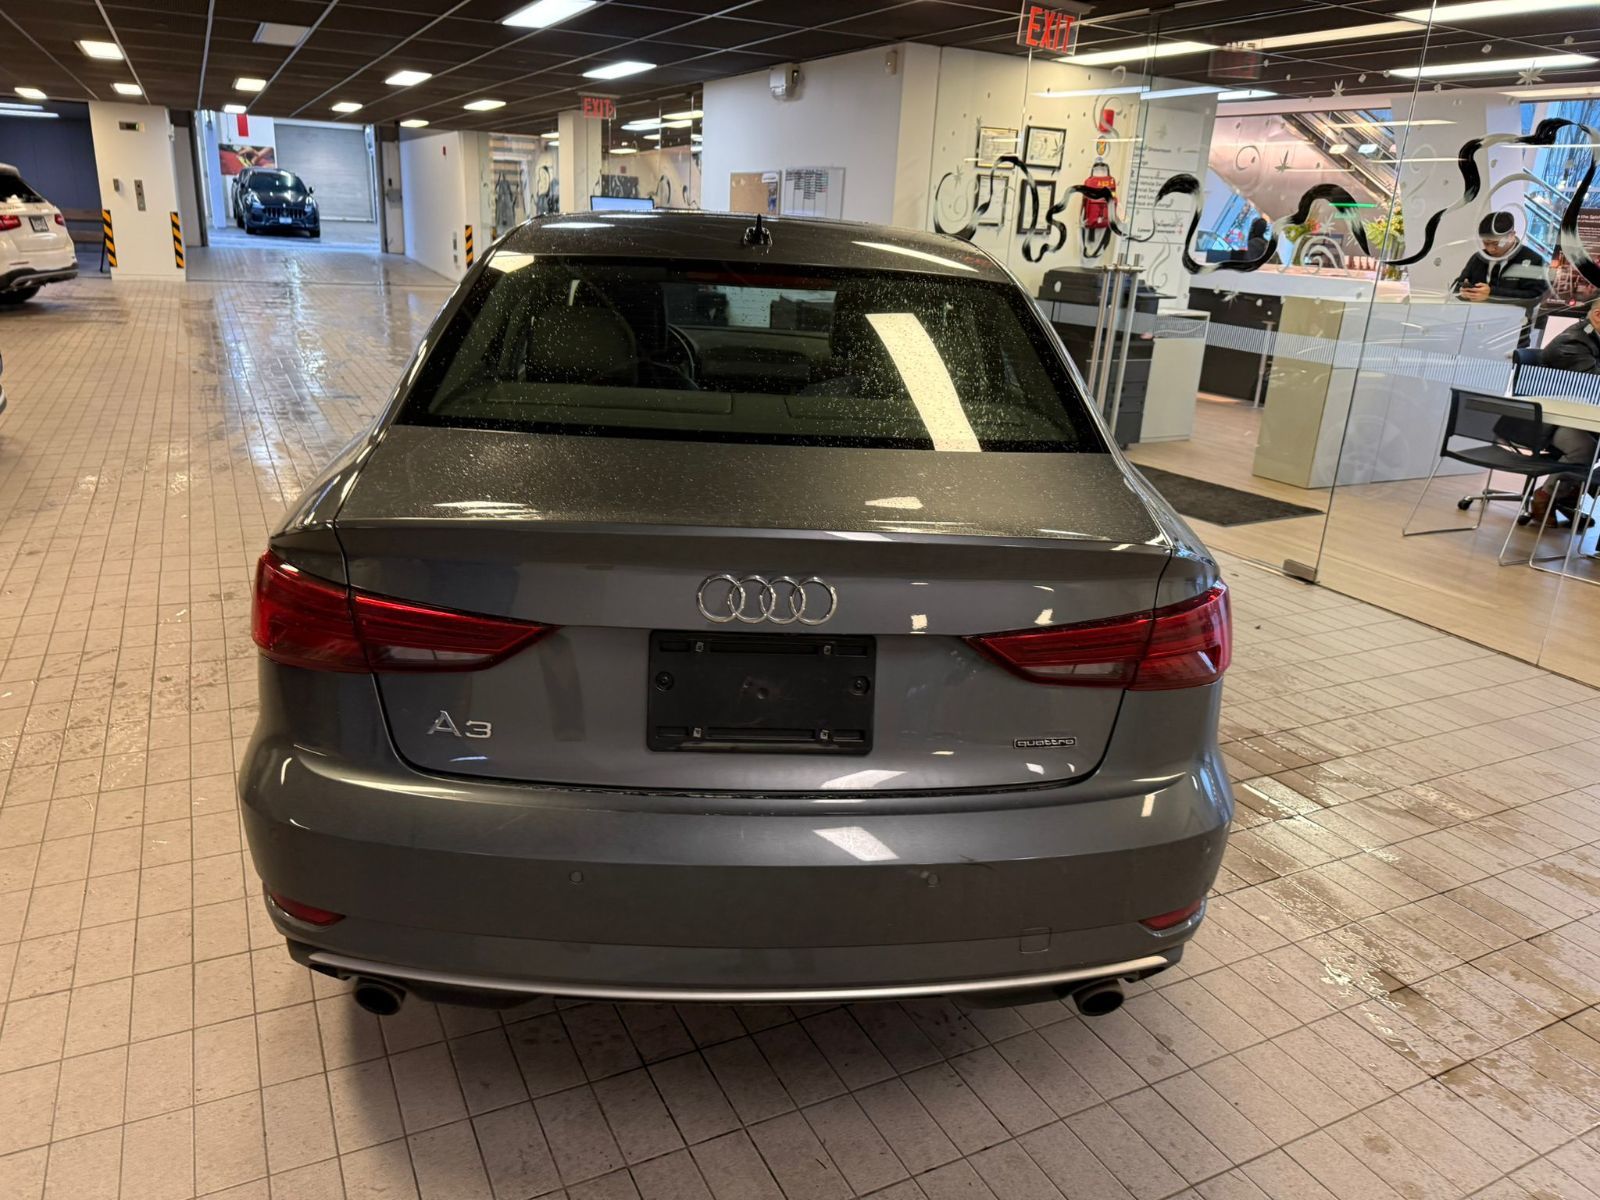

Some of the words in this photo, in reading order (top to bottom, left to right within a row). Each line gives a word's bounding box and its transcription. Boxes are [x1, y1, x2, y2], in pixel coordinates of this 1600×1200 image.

[1026, 6, 1075, 54] EXIT
[583, 97, 610, 118] EXIT
[427, 710, 491, 738] A3
[1017, 739, 1074, 747] quattro
